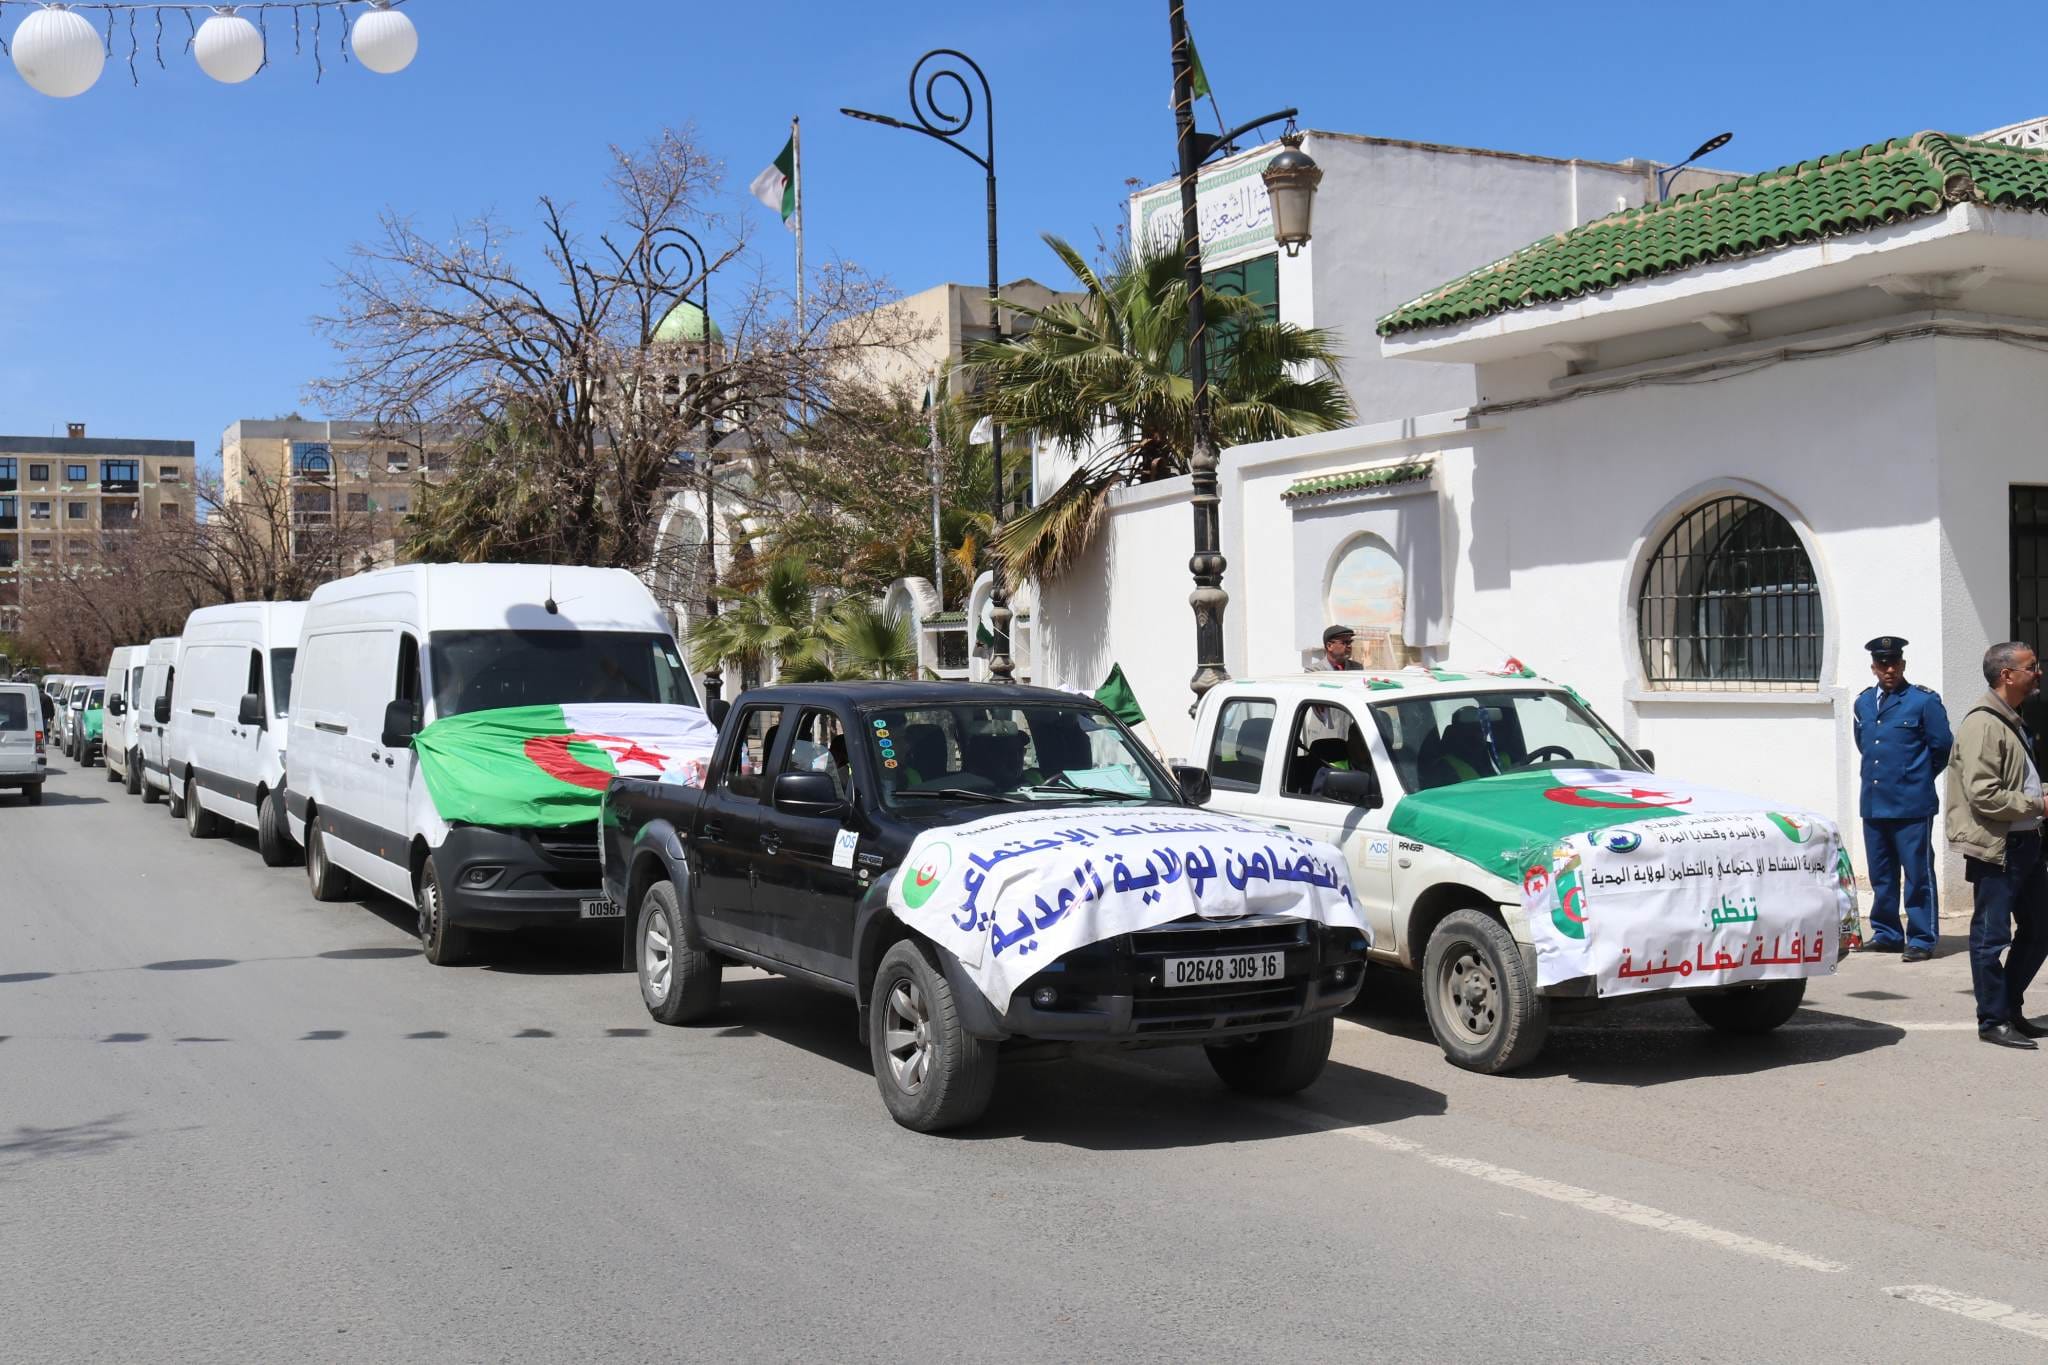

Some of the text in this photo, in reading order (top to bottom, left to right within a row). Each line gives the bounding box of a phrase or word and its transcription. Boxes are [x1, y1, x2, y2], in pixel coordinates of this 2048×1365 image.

[1369, 842, 1388, 854] ADS
[1634, 864, 1665, 884] لولاية
[1668, 859, 1713, 881] والتضامن
[1768, 856, 1801, 872] النشاط
[1803, 855, 1826, 875] مديرية
[1105, 845, 1217, 906] لولاية
[1592, 866, 1630, 888] المدية
[1618, 930, 1823, 984] قافلة تضامنية
[1176, 955, 1276, 983] 02648 309 16
